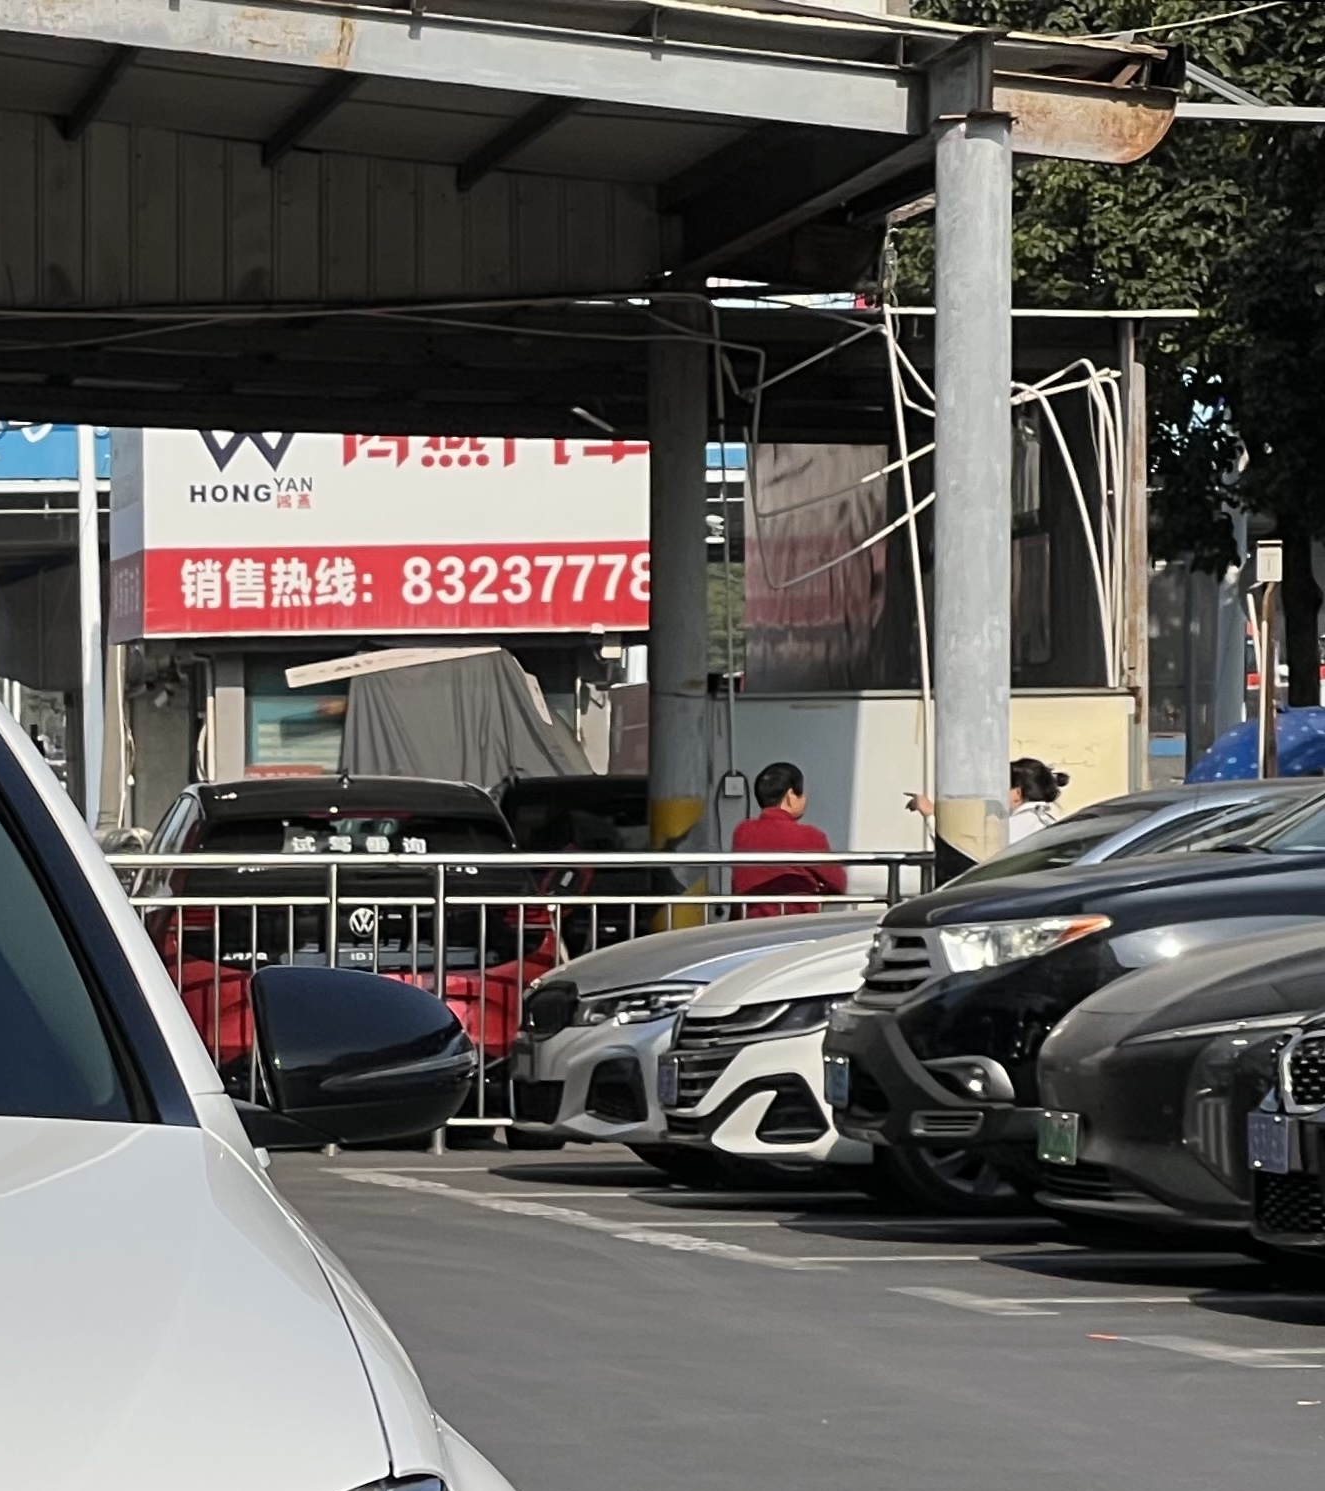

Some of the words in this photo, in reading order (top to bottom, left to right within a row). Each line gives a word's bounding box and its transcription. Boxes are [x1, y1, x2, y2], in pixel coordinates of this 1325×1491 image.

[190, 484, 272, 502] HONG
[273, 477, 313, 492] YAN
[402, 551, 650, 605] 83237778
